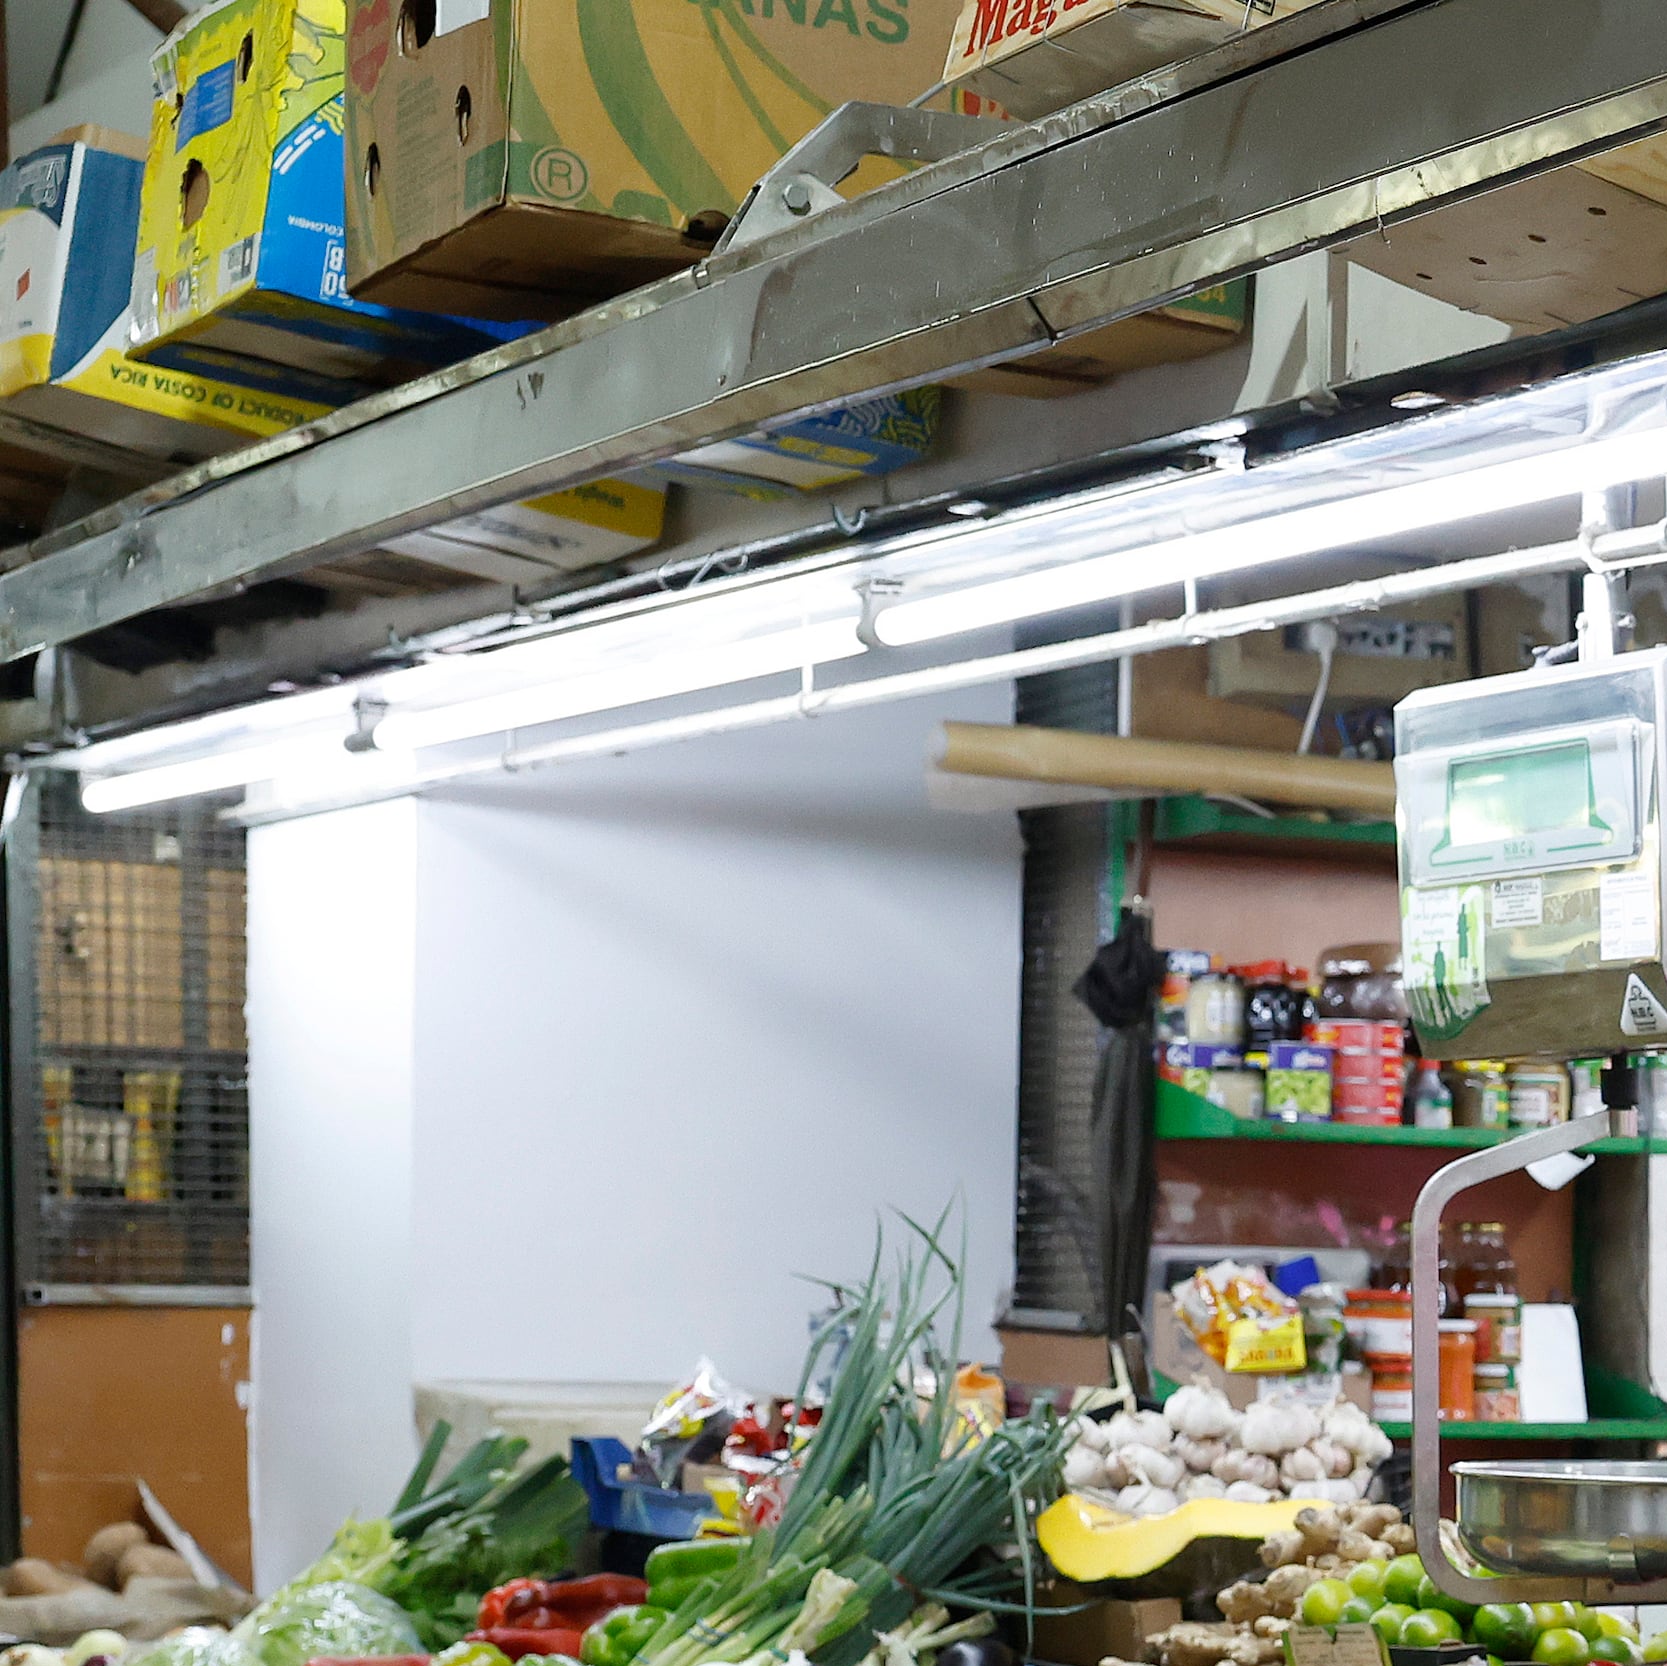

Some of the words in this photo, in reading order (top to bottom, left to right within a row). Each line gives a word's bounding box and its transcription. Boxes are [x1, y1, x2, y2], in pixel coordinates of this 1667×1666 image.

[110, 364, 147, 388] RICA
[154, 375, 206, 403] COSTA
[211, 392, 234, 410] OF
